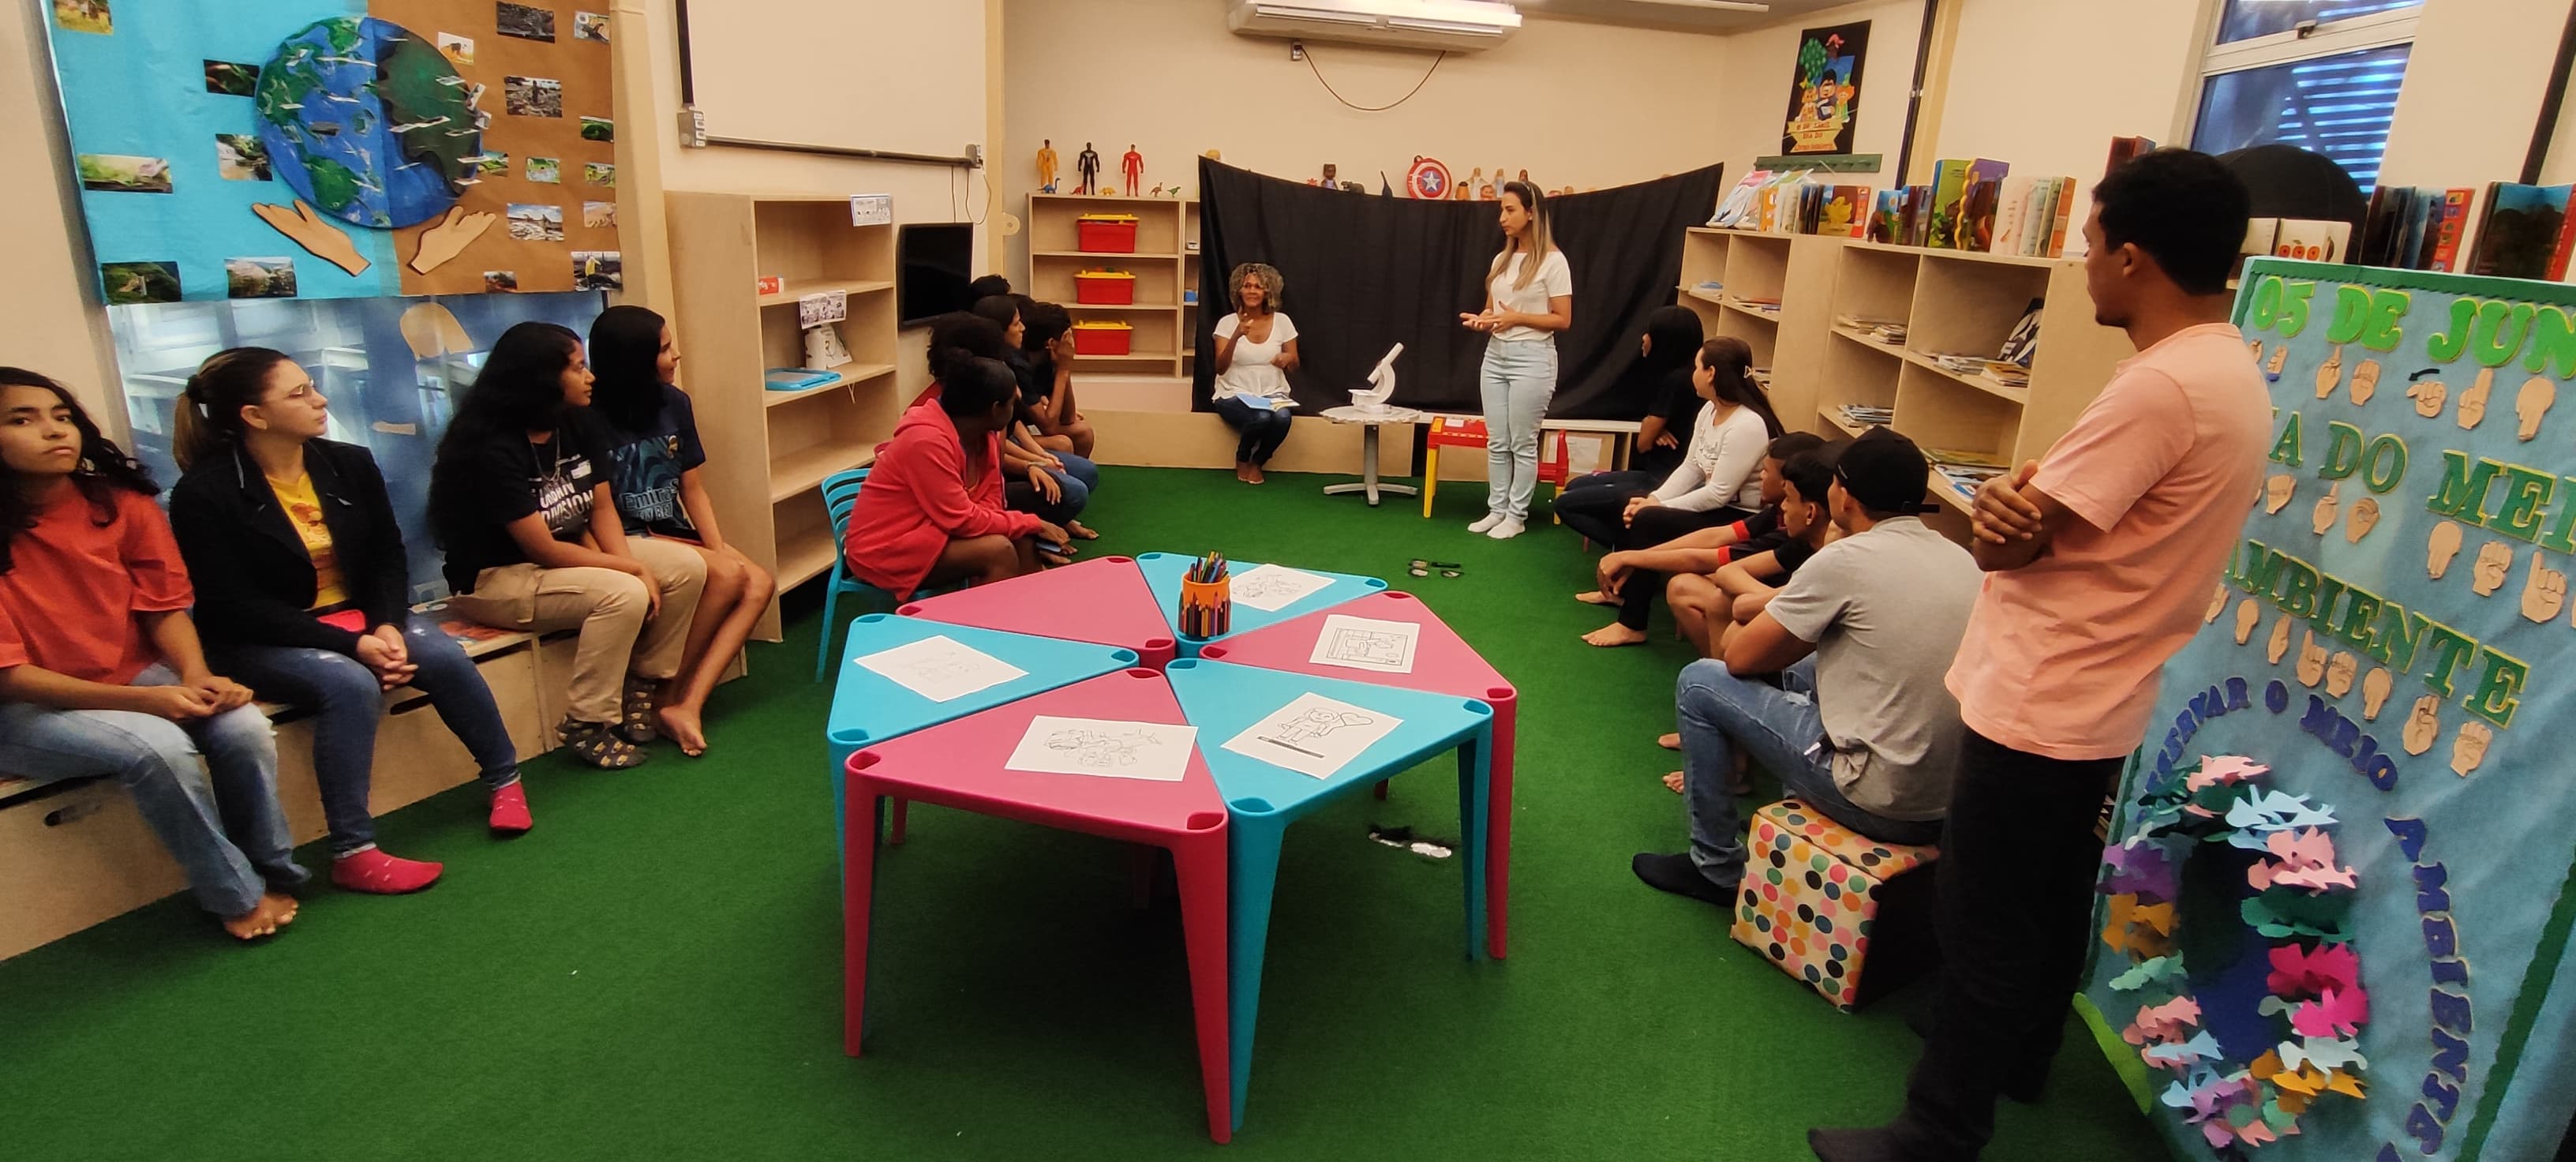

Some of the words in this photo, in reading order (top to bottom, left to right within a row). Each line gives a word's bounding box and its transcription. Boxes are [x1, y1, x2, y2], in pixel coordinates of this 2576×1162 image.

[2252, 276, 2317, 338] 05
[2325, 284, 2412, 353] DE
[2318, 420, 2409, 494] DO
[2424, 448, 2576, 556] MEI
[2265, 679, 2289, 714] O
[2298, 694, 2399, 791] MEIO
